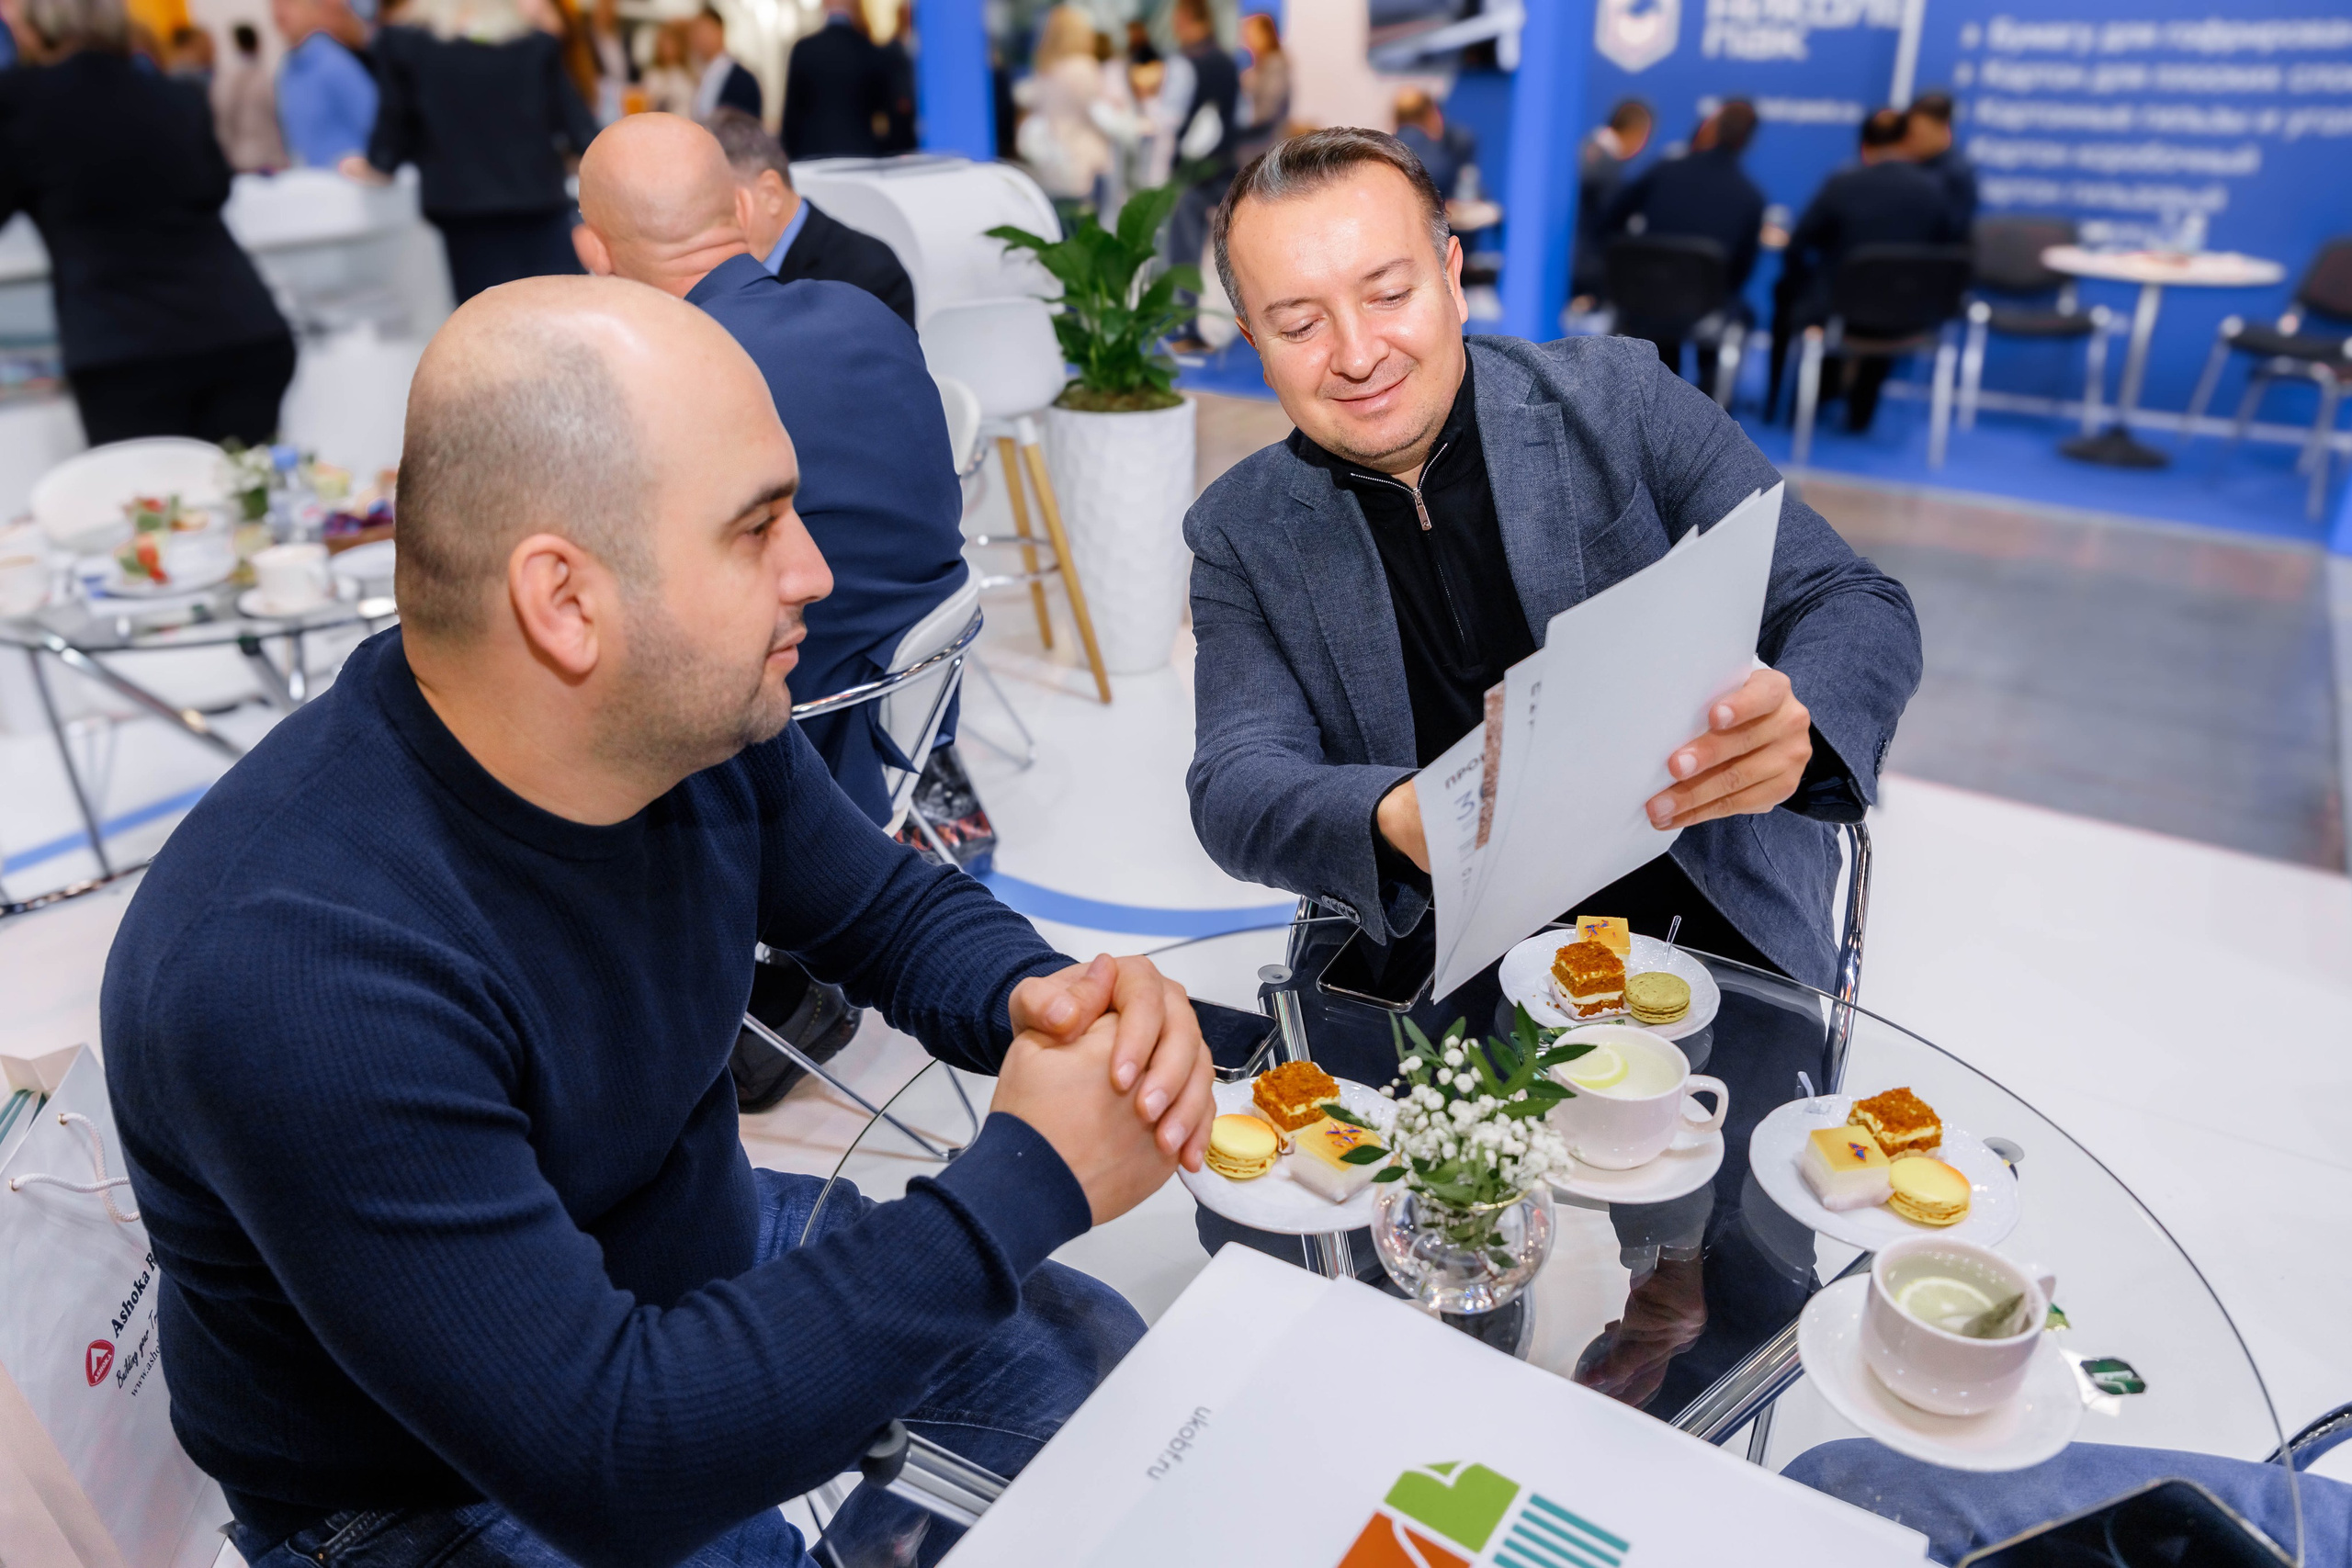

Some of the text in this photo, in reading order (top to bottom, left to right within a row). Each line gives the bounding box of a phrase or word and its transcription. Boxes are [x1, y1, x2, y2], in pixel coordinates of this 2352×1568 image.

[111, 1270, 151, 1339] Ashoka
[94, 1353, 113, 1382] ASHOKA
[131, 1338, 160, 1397] www.asho
